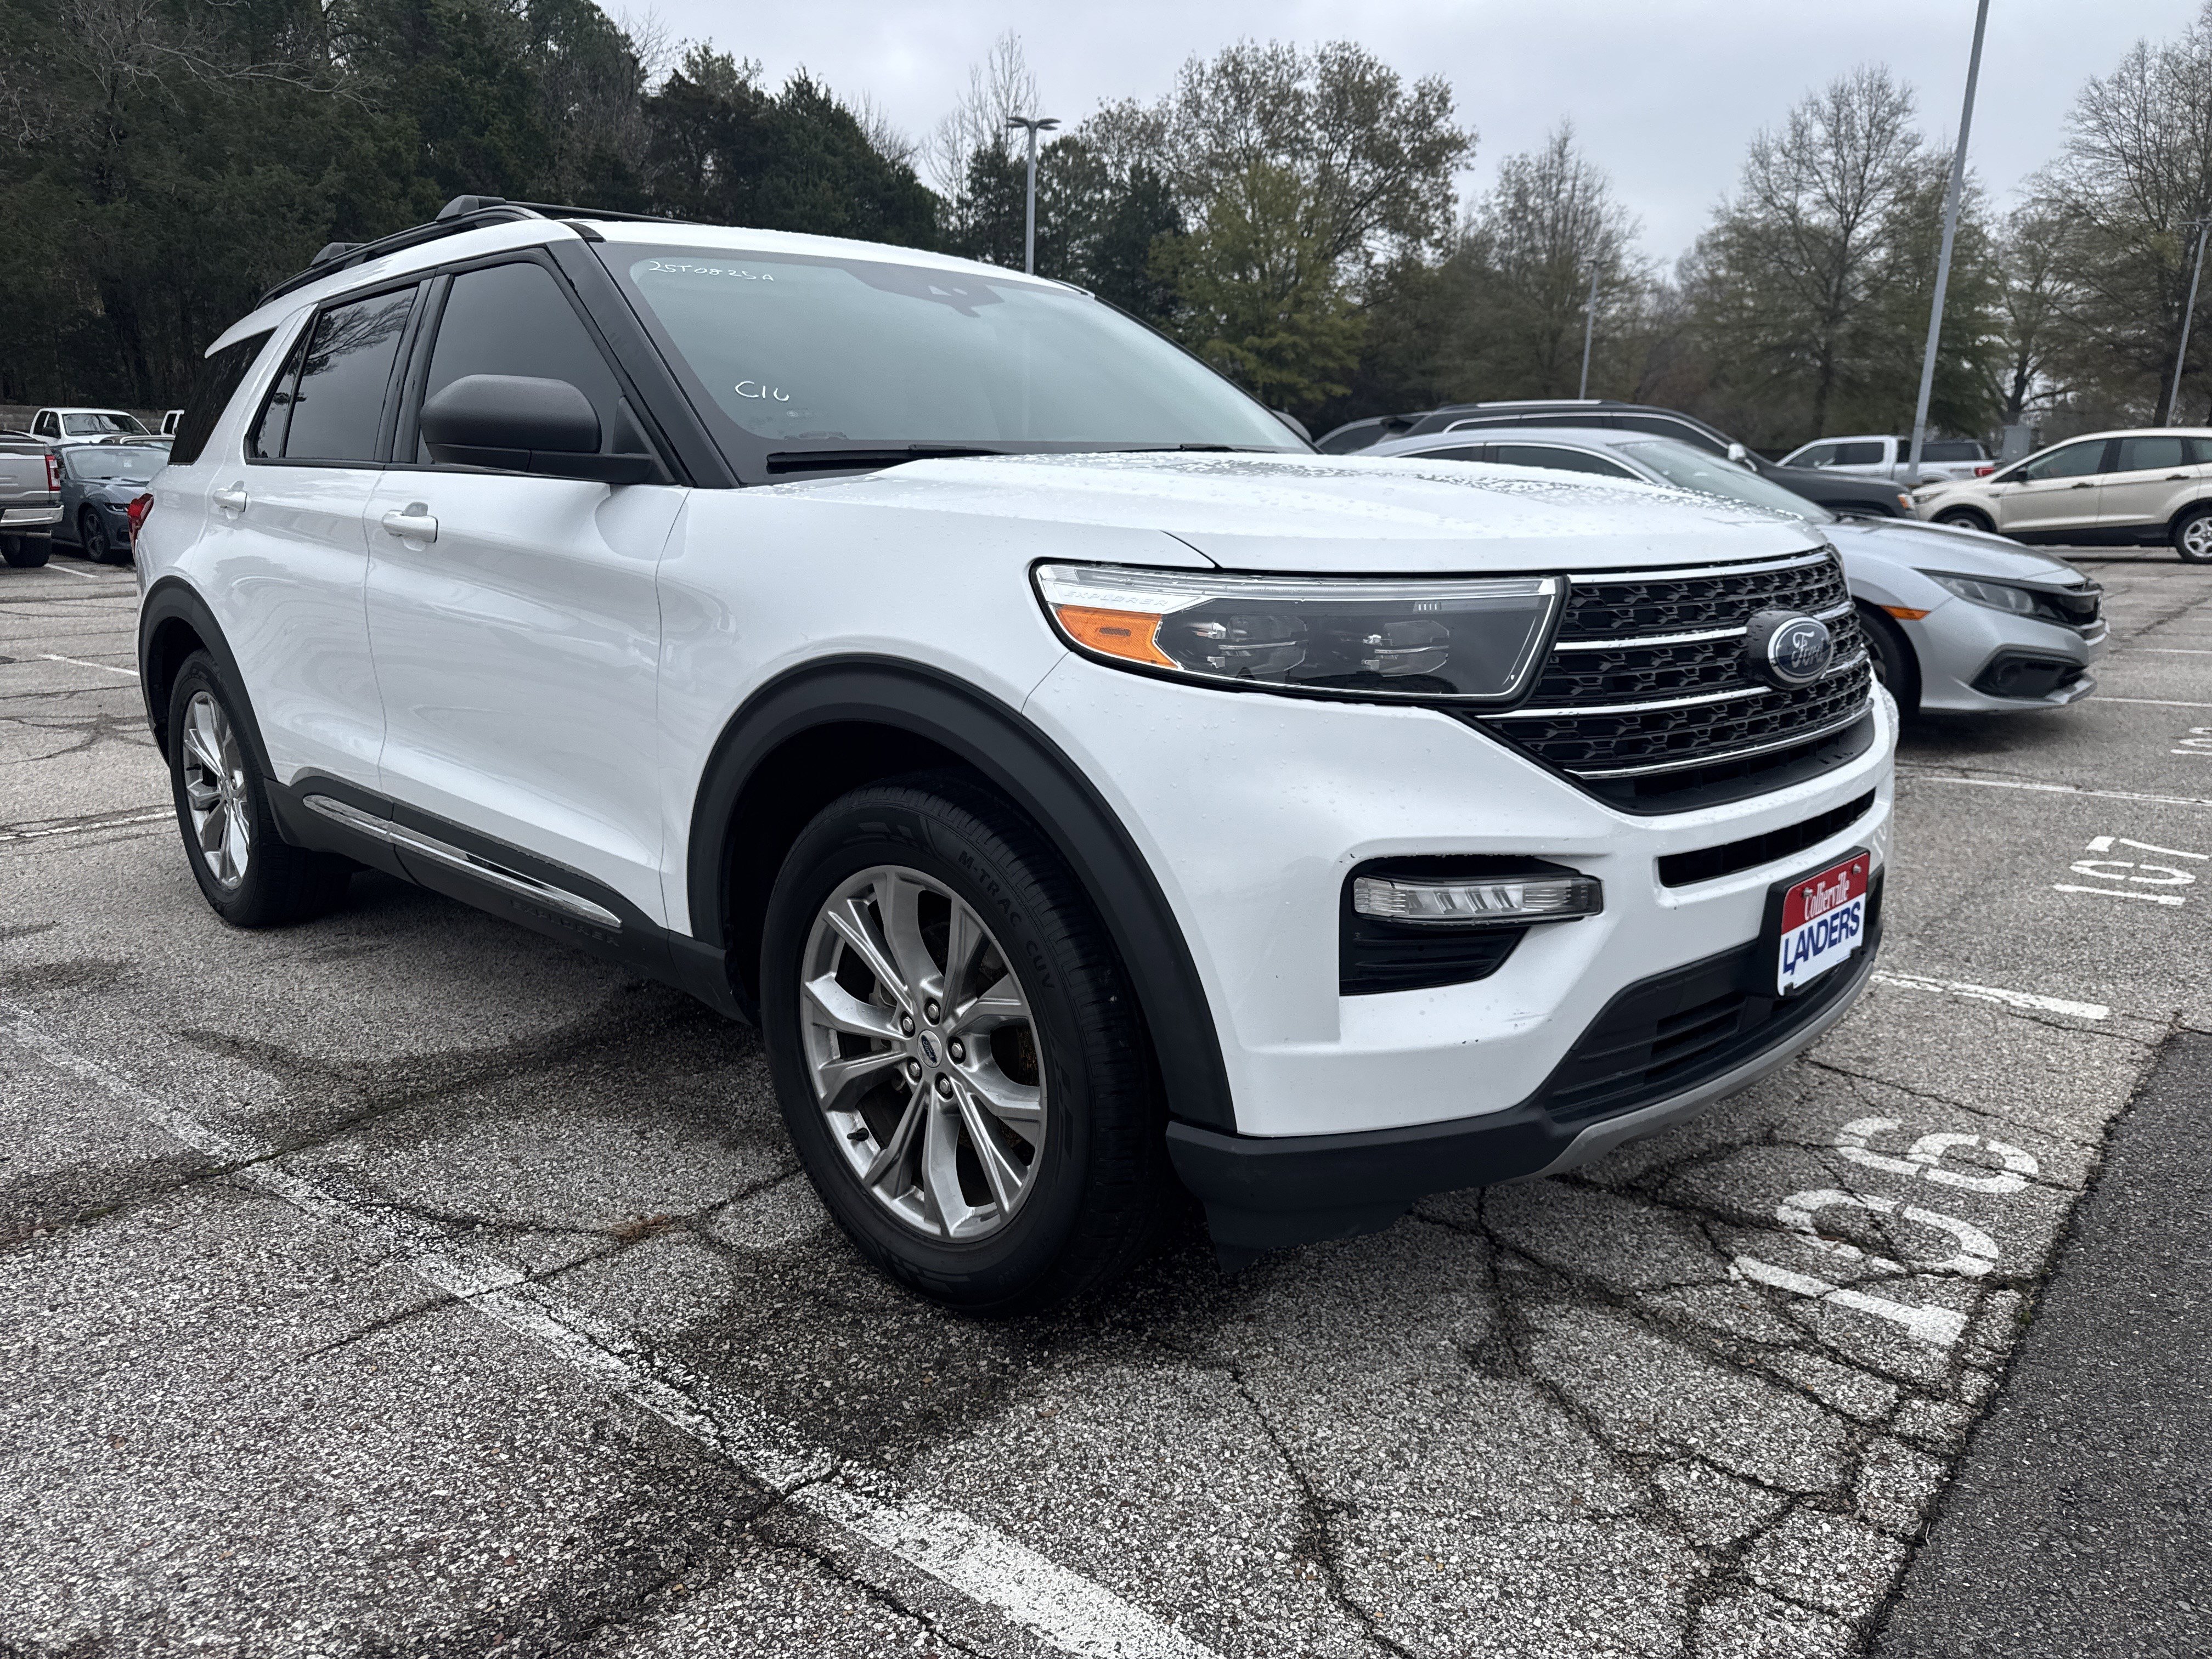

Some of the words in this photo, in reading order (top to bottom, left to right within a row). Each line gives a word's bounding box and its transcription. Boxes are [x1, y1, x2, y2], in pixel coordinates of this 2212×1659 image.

[1064, 591, 1169, 606] EXPLORER
[1792, 631, 1825, 668] Ford
[2053, 836, 2209, 906] 107
[510, 899, 620, 947] EXPLORER
[958, 850, 1022, 927] M-TRAC
[1026, 940, 1054, 988] CUV
[1783, 901, 1861, 975] LANDERS
[923, 1041, 934, 1058] Ford
